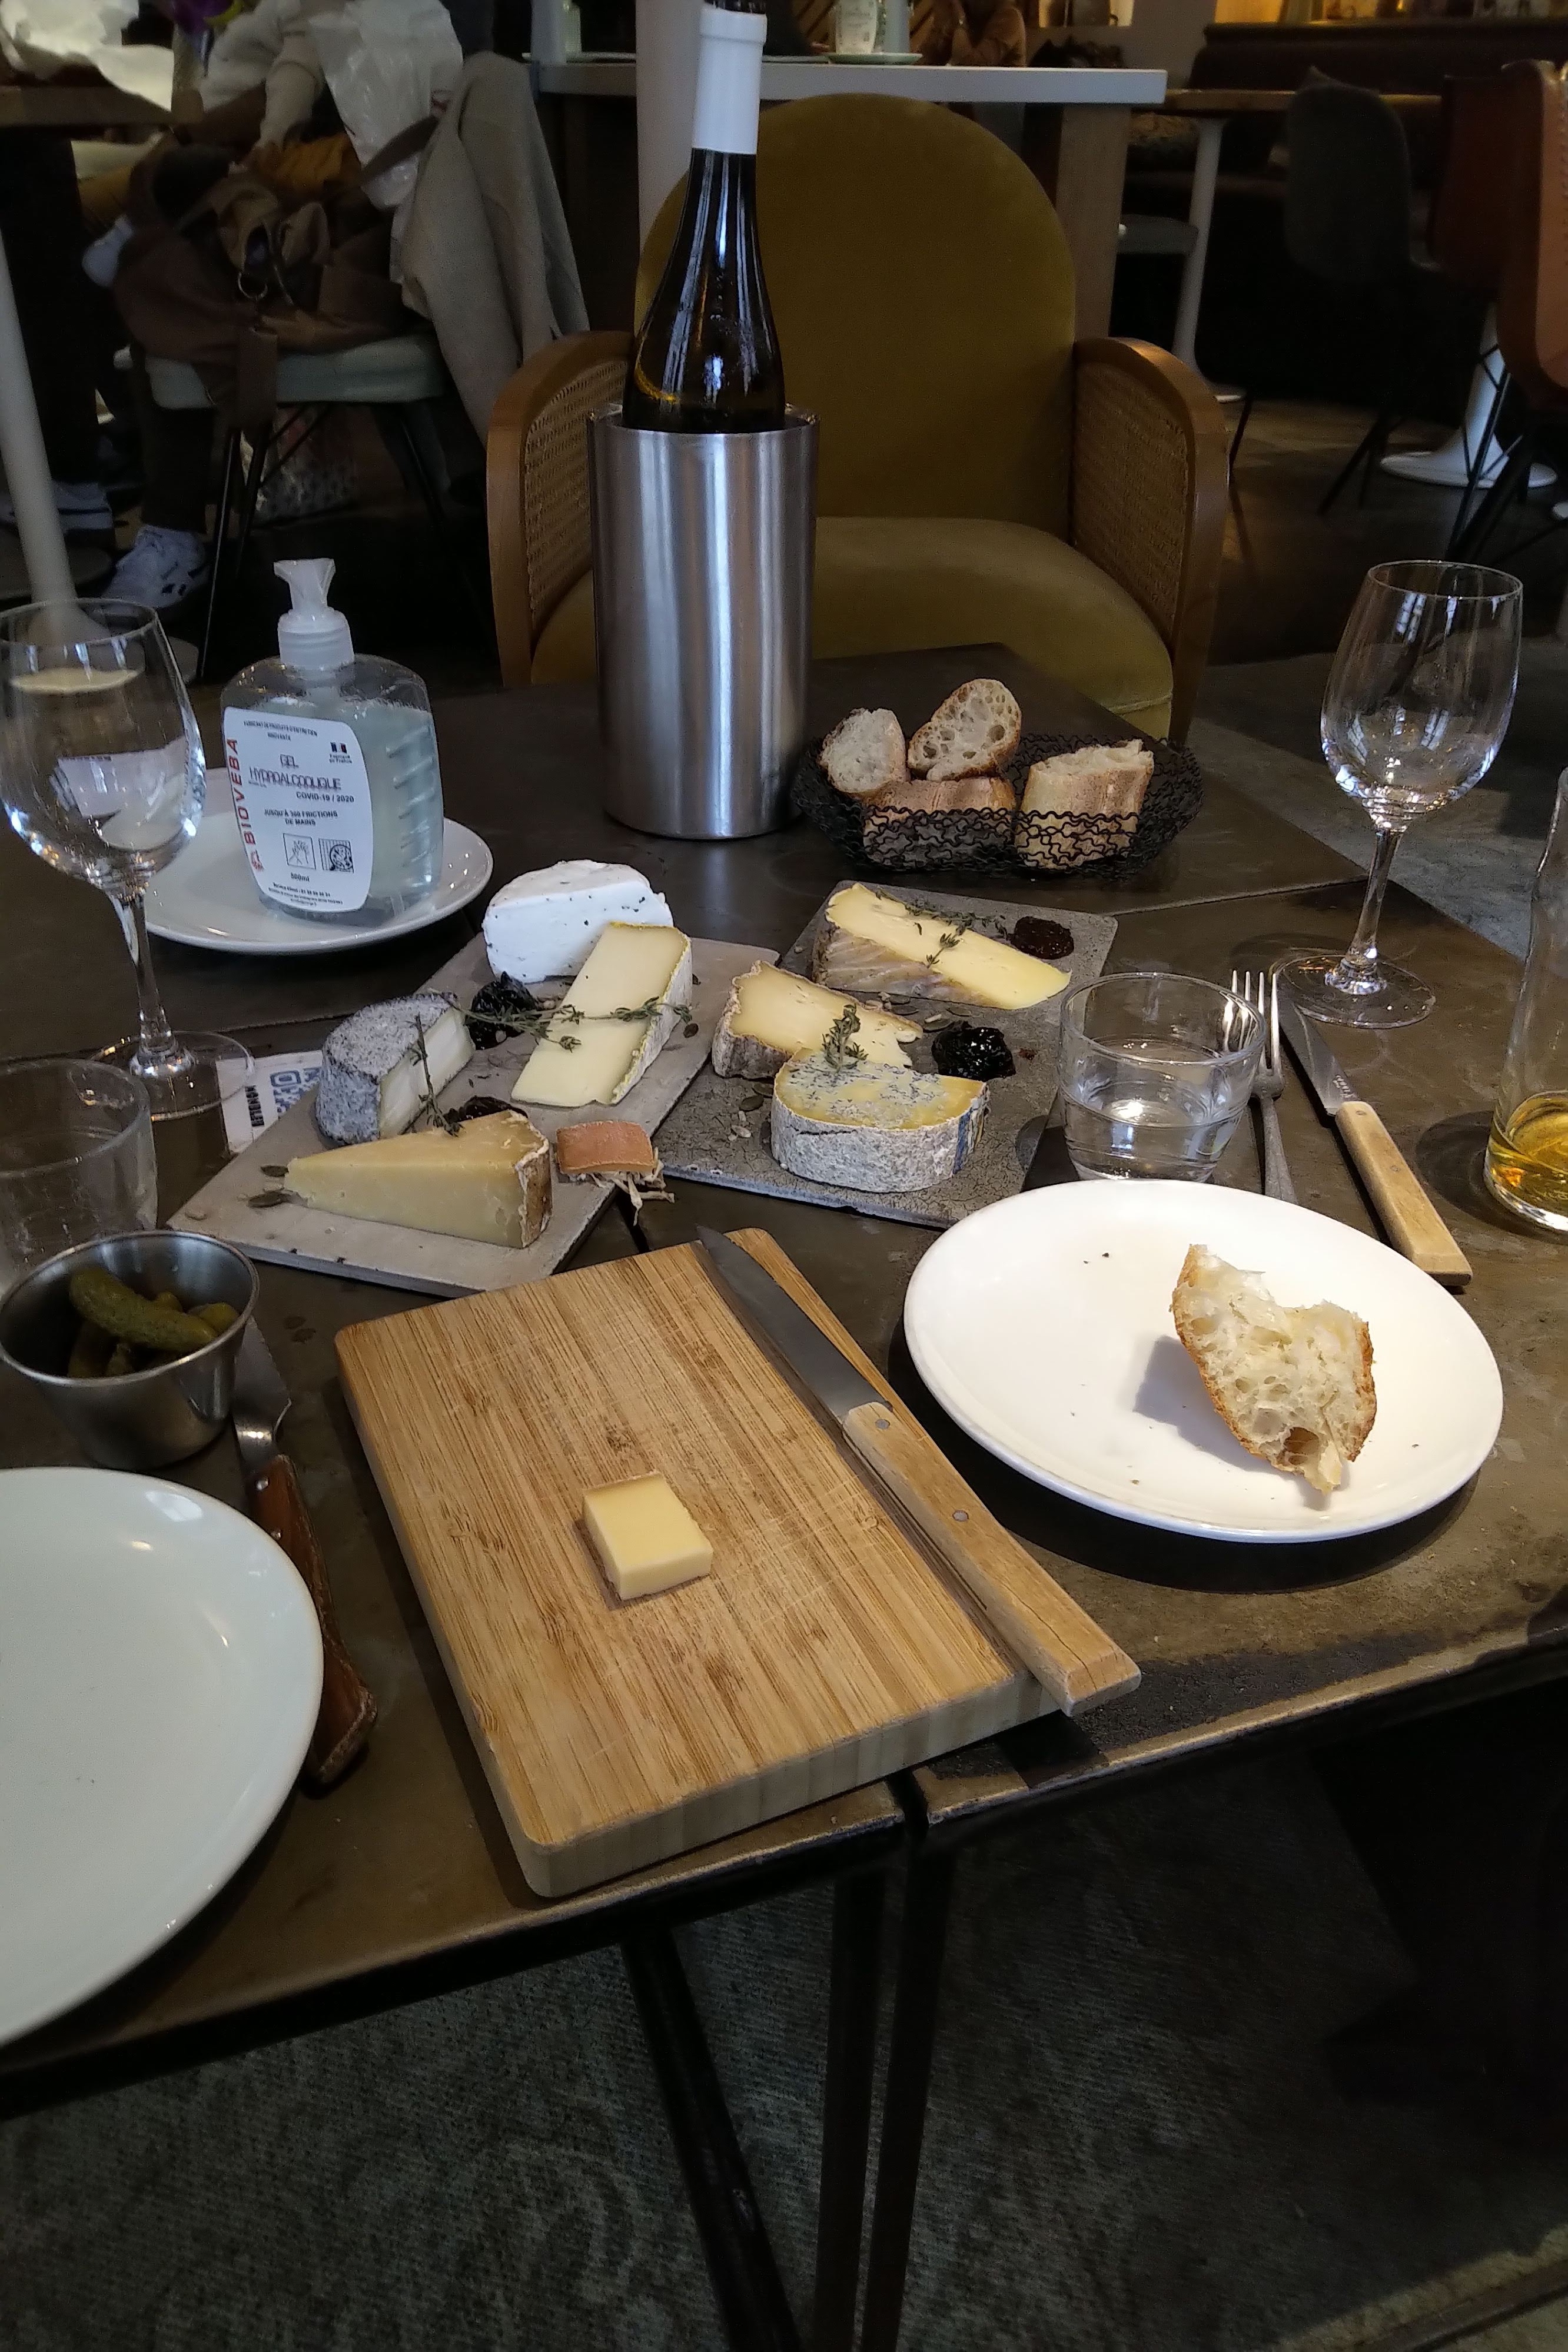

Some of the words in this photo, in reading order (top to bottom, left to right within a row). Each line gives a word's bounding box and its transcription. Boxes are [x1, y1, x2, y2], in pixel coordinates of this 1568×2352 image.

[249, 765, 341, 790] HYDROALCOOLIQUE
[227, 739, 256, 845] BIOVEBA
[296, 791, 330, 802] COVID-19
[336, 794, 354, 803] 2020
[302, 810, 338, 819] FRICTIONS
